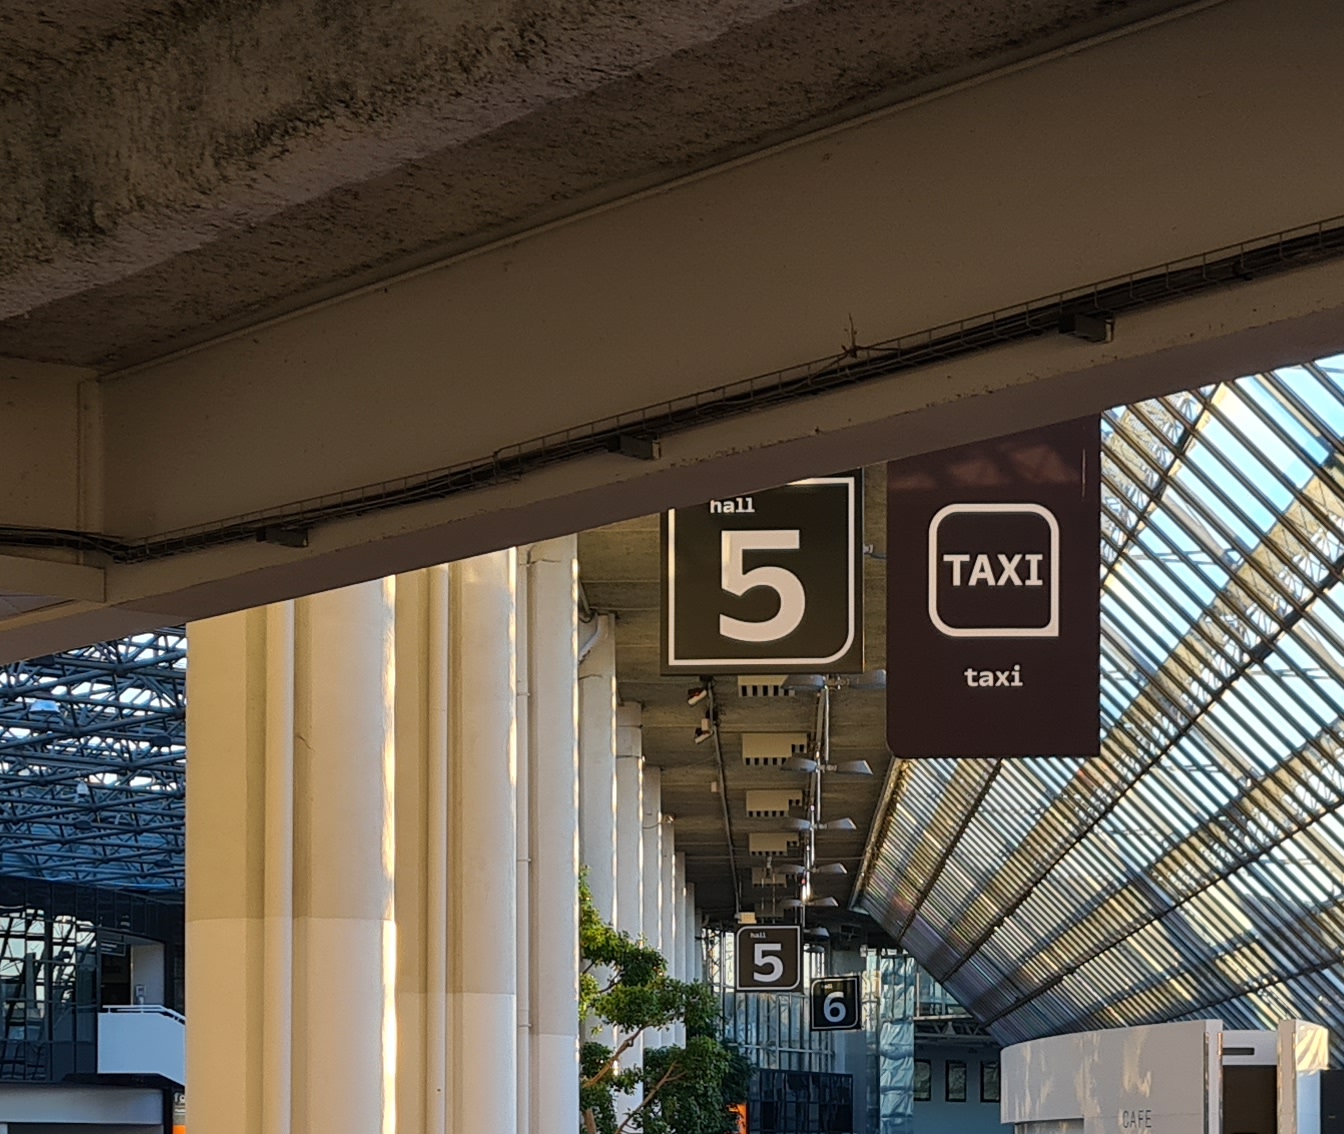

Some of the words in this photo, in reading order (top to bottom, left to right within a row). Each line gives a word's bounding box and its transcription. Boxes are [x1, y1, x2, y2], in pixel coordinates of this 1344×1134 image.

[942, 554, 1044, 586] TAXI
[720, 530, 805, 642] 5
[964, 665, 1023, 687] taxi
[753, 943, 783, 983] 5
[823, 991, 846, 1022] 6
[1122, 1109, 1152, 1128] CAFE
